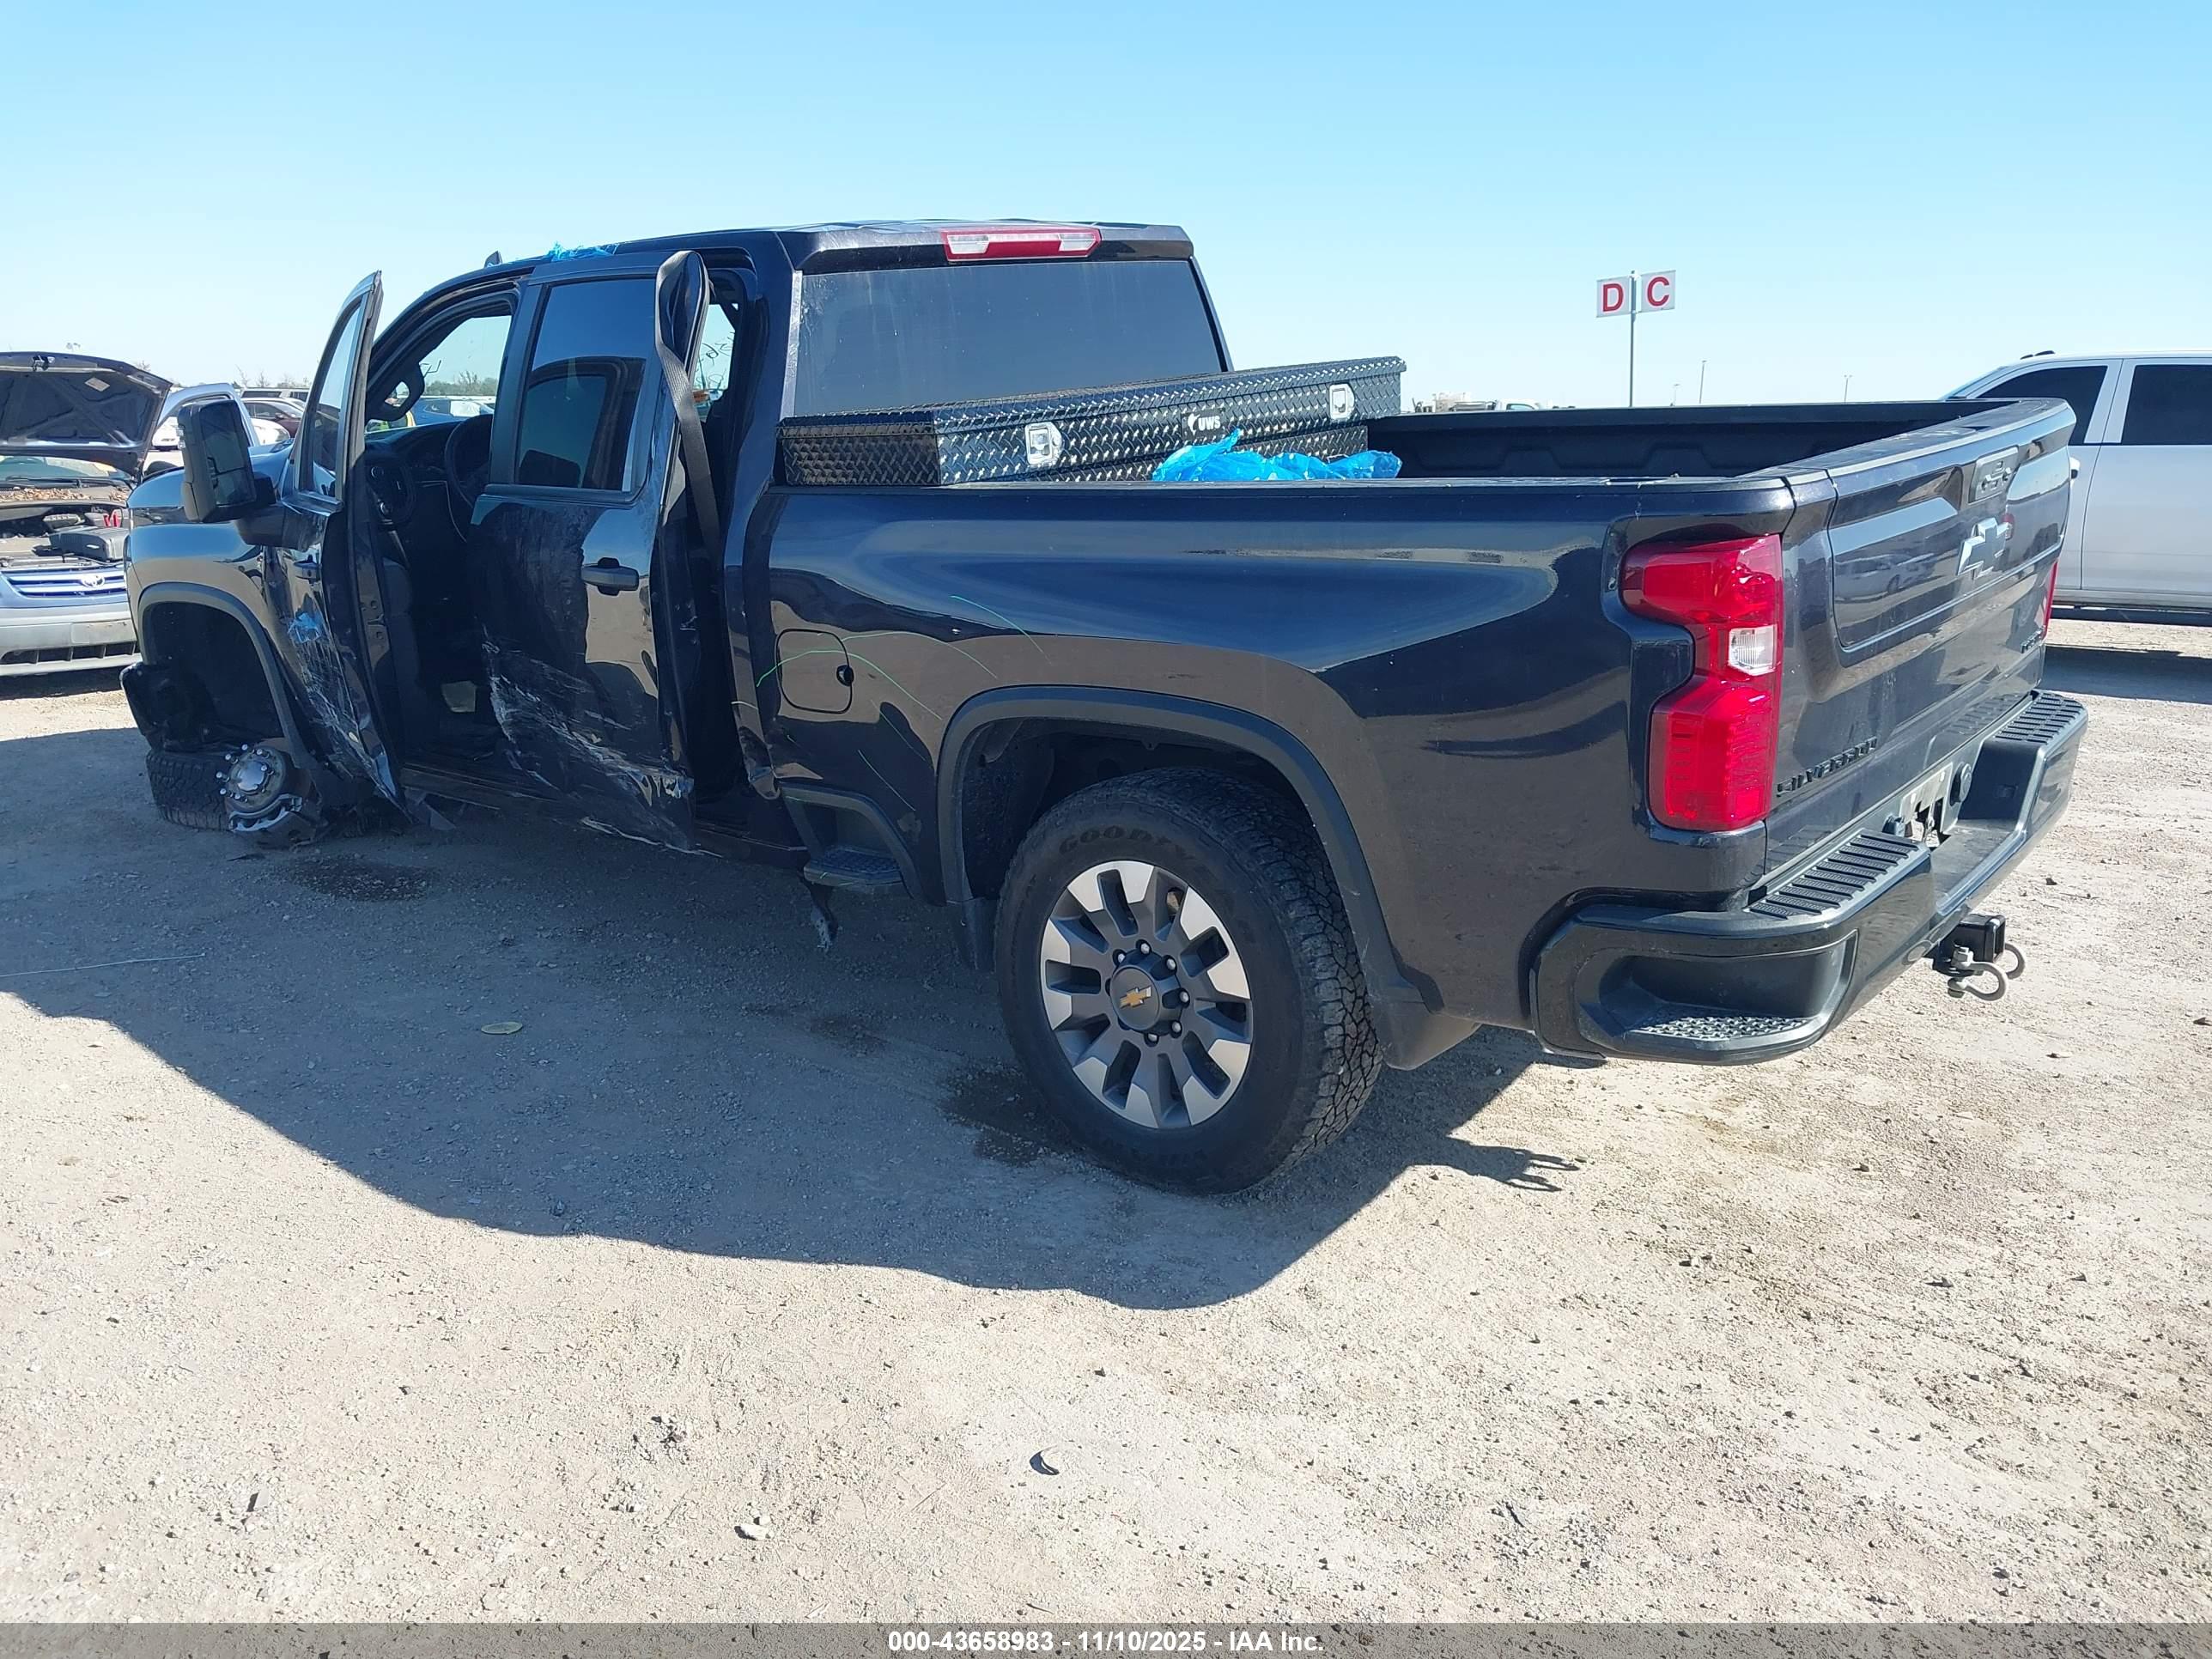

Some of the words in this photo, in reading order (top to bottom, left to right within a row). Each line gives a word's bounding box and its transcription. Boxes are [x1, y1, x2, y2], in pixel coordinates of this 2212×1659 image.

[1602, 283, 1624, 313] D
[1646, 276, 1670, 307] C
[1198, 415, 1221, 432] UWS
